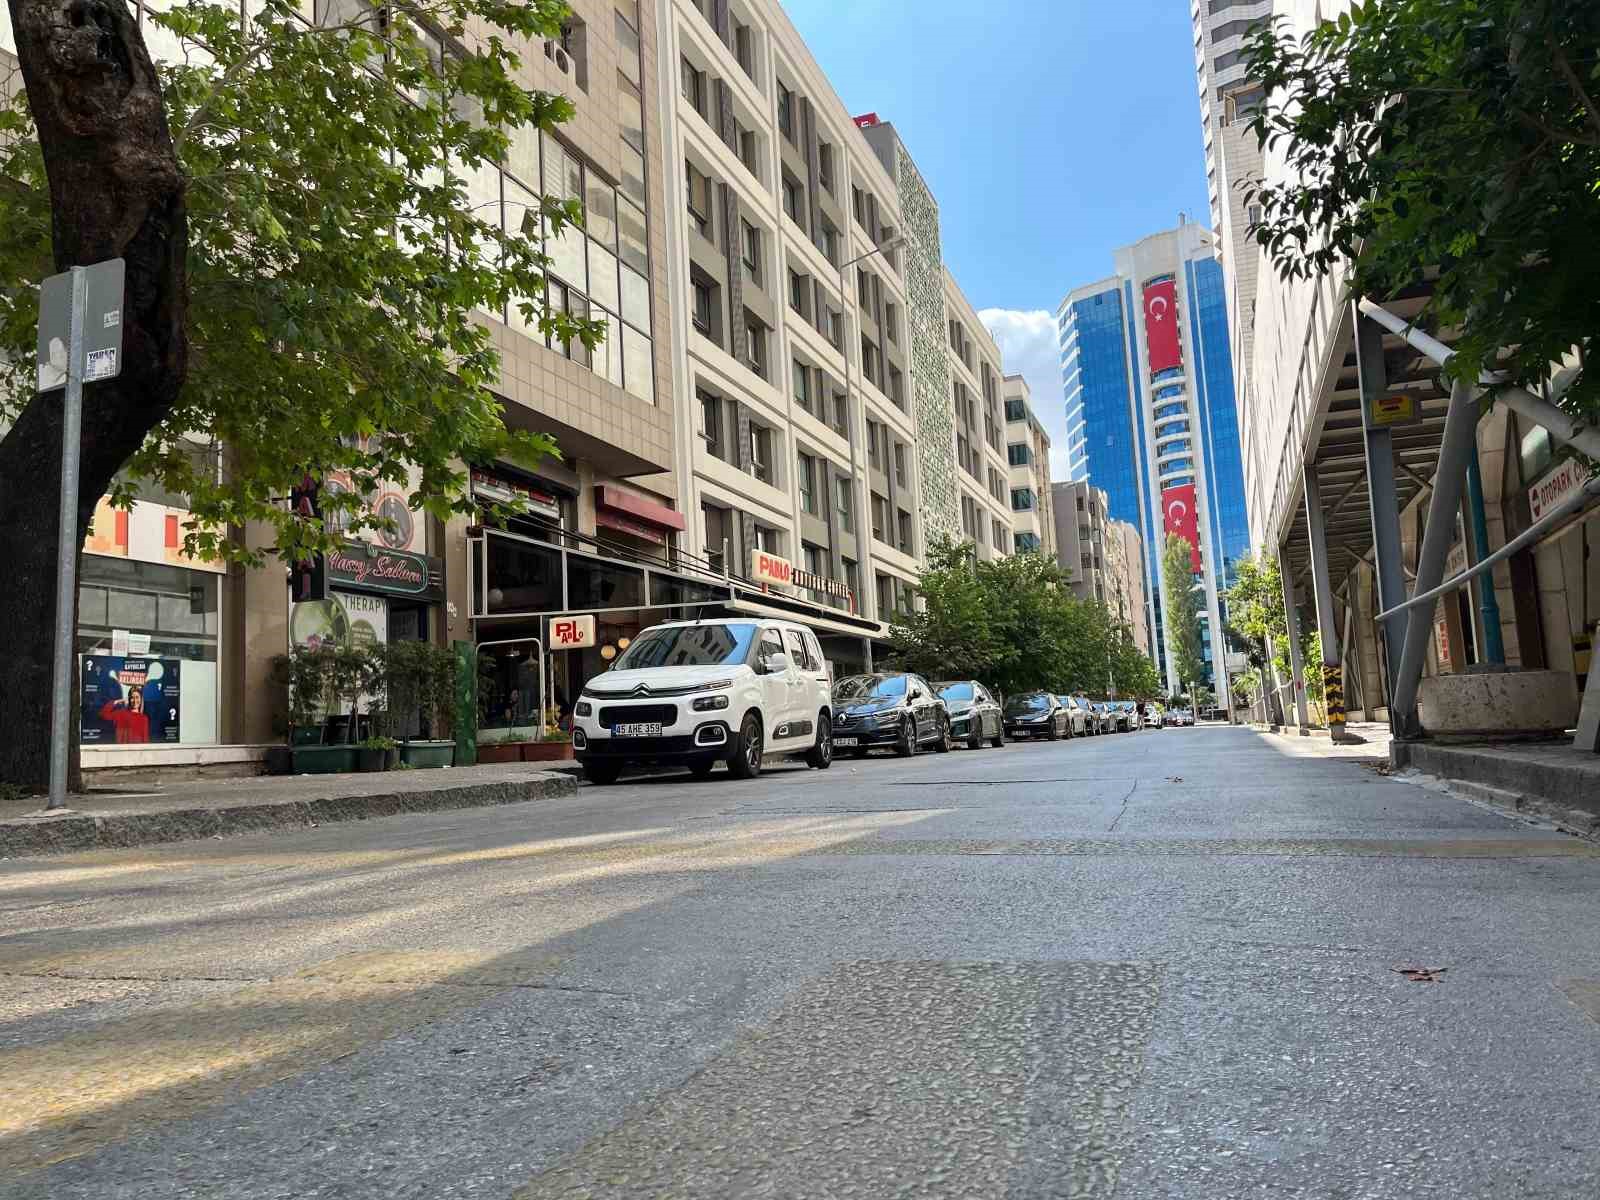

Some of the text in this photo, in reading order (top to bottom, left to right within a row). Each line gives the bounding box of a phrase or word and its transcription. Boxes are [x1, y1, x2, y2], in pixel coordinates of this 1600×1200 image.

[1541, 466, 1572, 506] OTOPARK
[760, 555, 790, 582] PABLO
[344, 595, 386, 614] THERAPY
